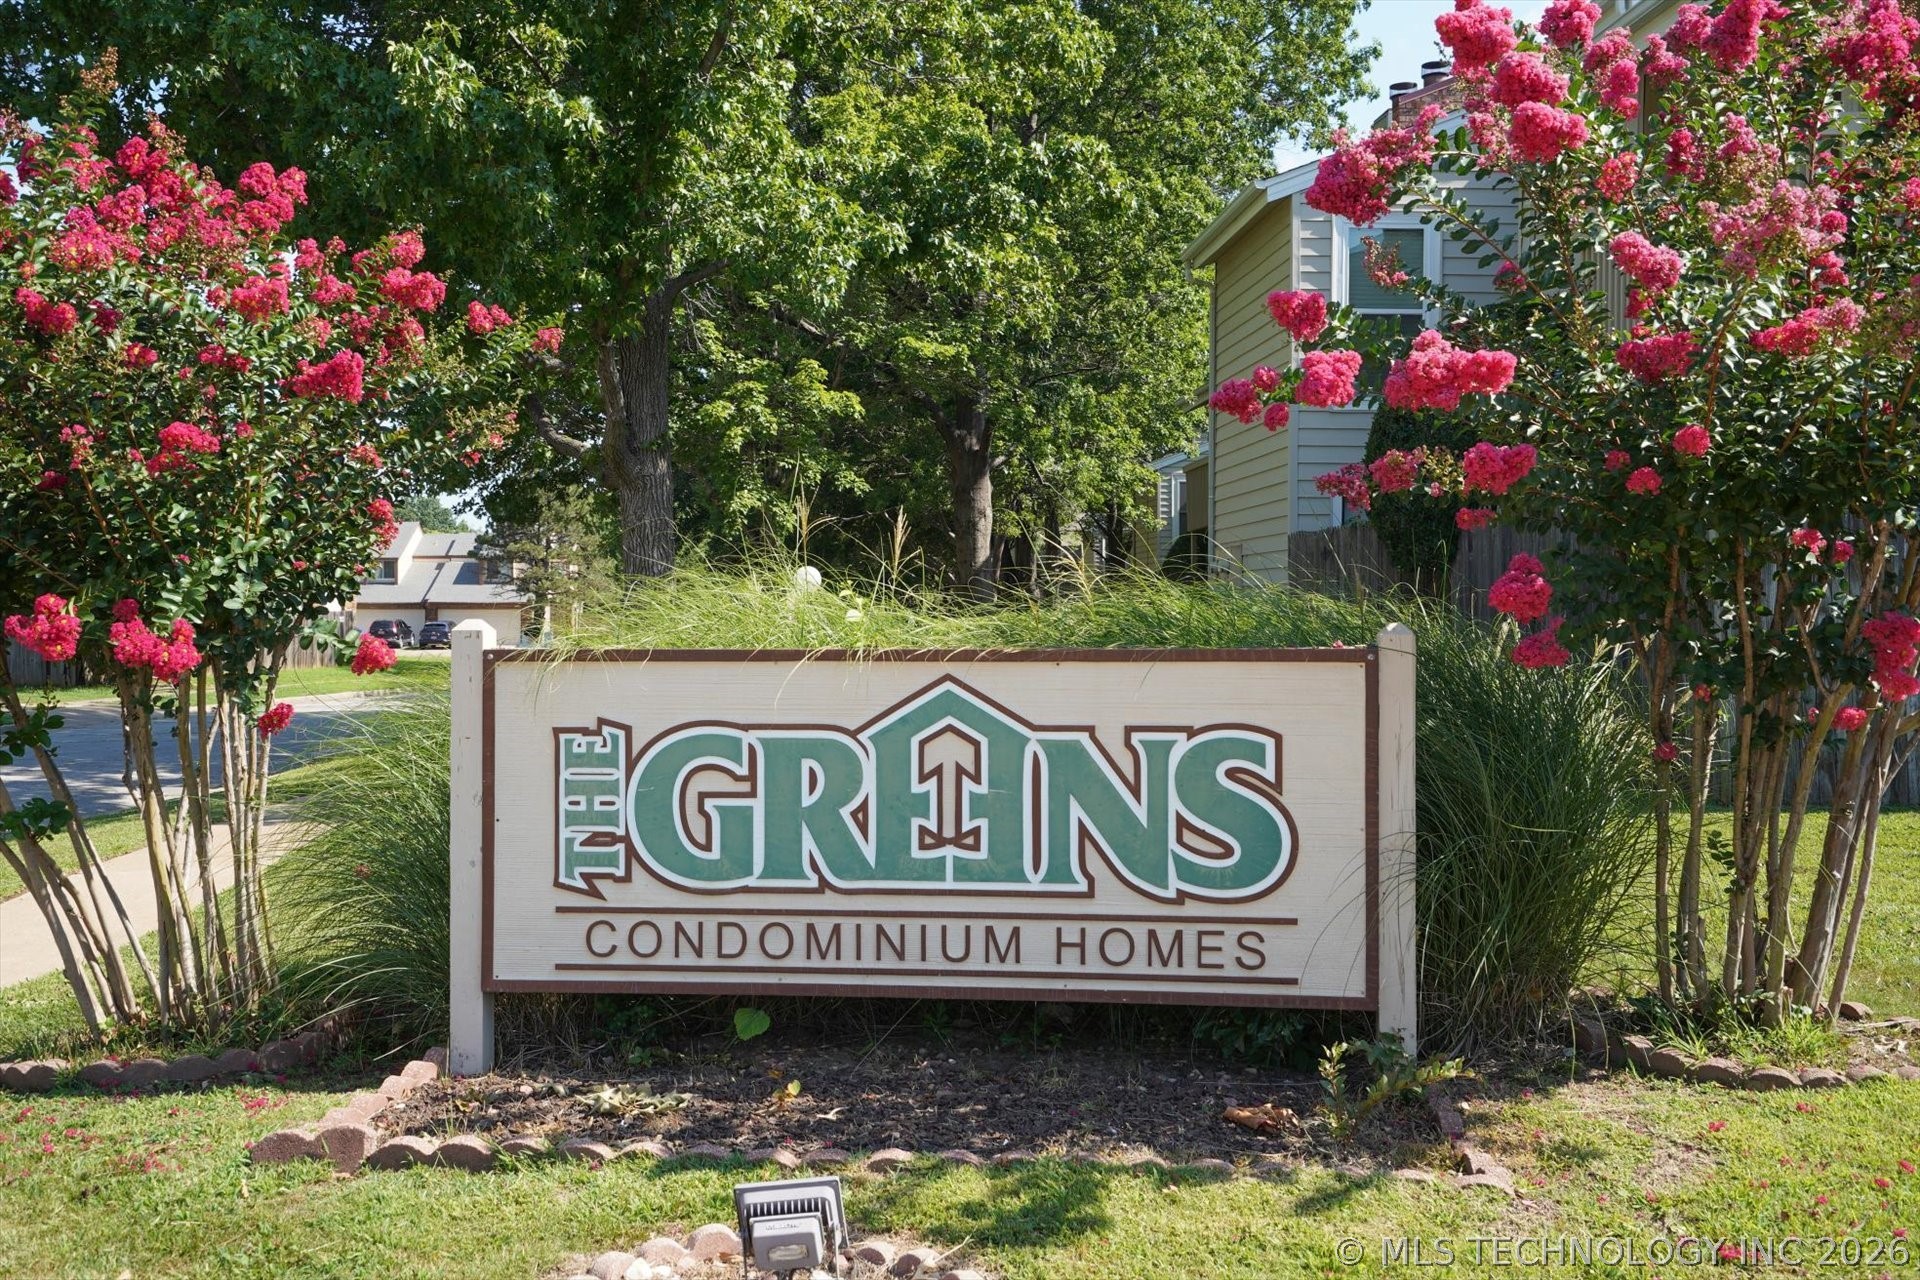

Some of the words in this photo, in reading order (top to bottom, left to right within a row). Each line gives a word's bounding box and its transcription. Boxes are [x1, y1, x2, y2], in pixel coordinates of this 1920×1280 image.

[553, 717, 632, 901] THE
[626, 674, 1298, 905] GREENS
[585, 919, 1021, 964] CONDOMINIUM
[1056, 926, 1266, 971] HOMES
